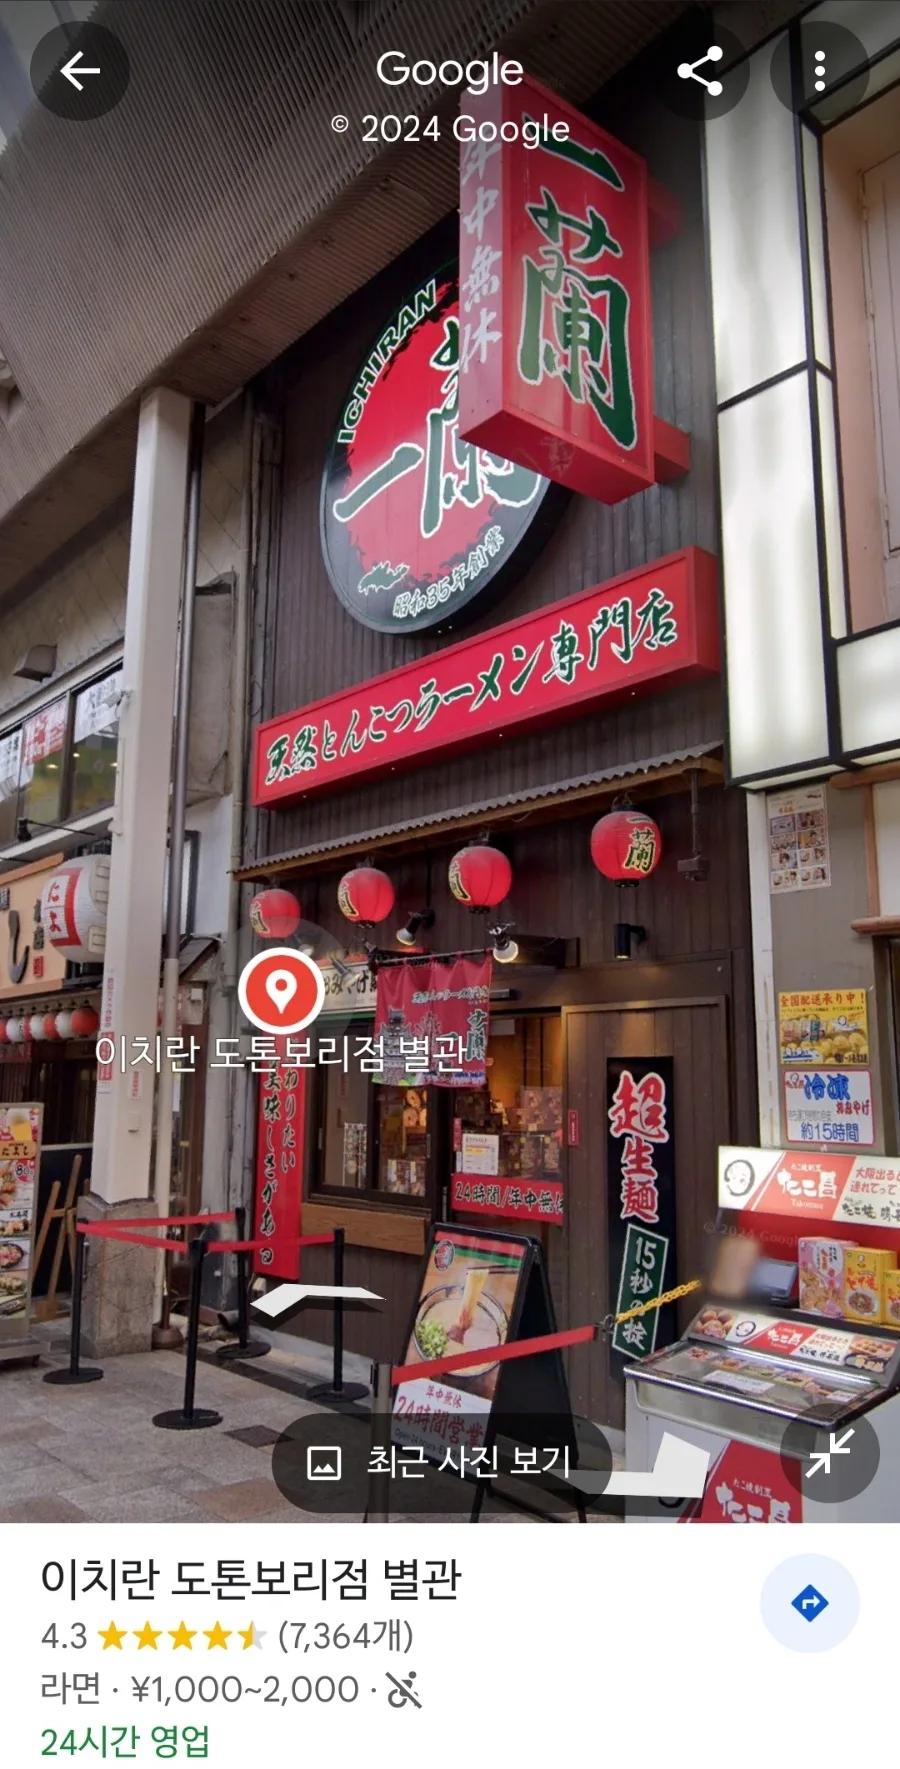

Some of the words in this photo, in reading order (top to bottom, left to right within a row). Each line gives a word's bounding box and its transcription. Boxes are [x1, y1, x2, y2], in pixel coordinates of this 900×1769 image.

[518, 112, 638, 450] 一蘭
[337, 279, 438, 446] ICHIRAN
[393, 525, 505, 619] 昭和35年創業
[264, 587, 680, 785] 天然とんこつラーメン専門店
[622, 815, 657, 874] 一蘭
[804, 1072, 851, 1100] 冷凍
[607, 1070, 669, 1223] 超生麺
[801, 1122, 860, 1142] 約15時間
[776, 1167, 837, 1200] たこ昌
[393, 1395, 484, 1449] 24時間営業
